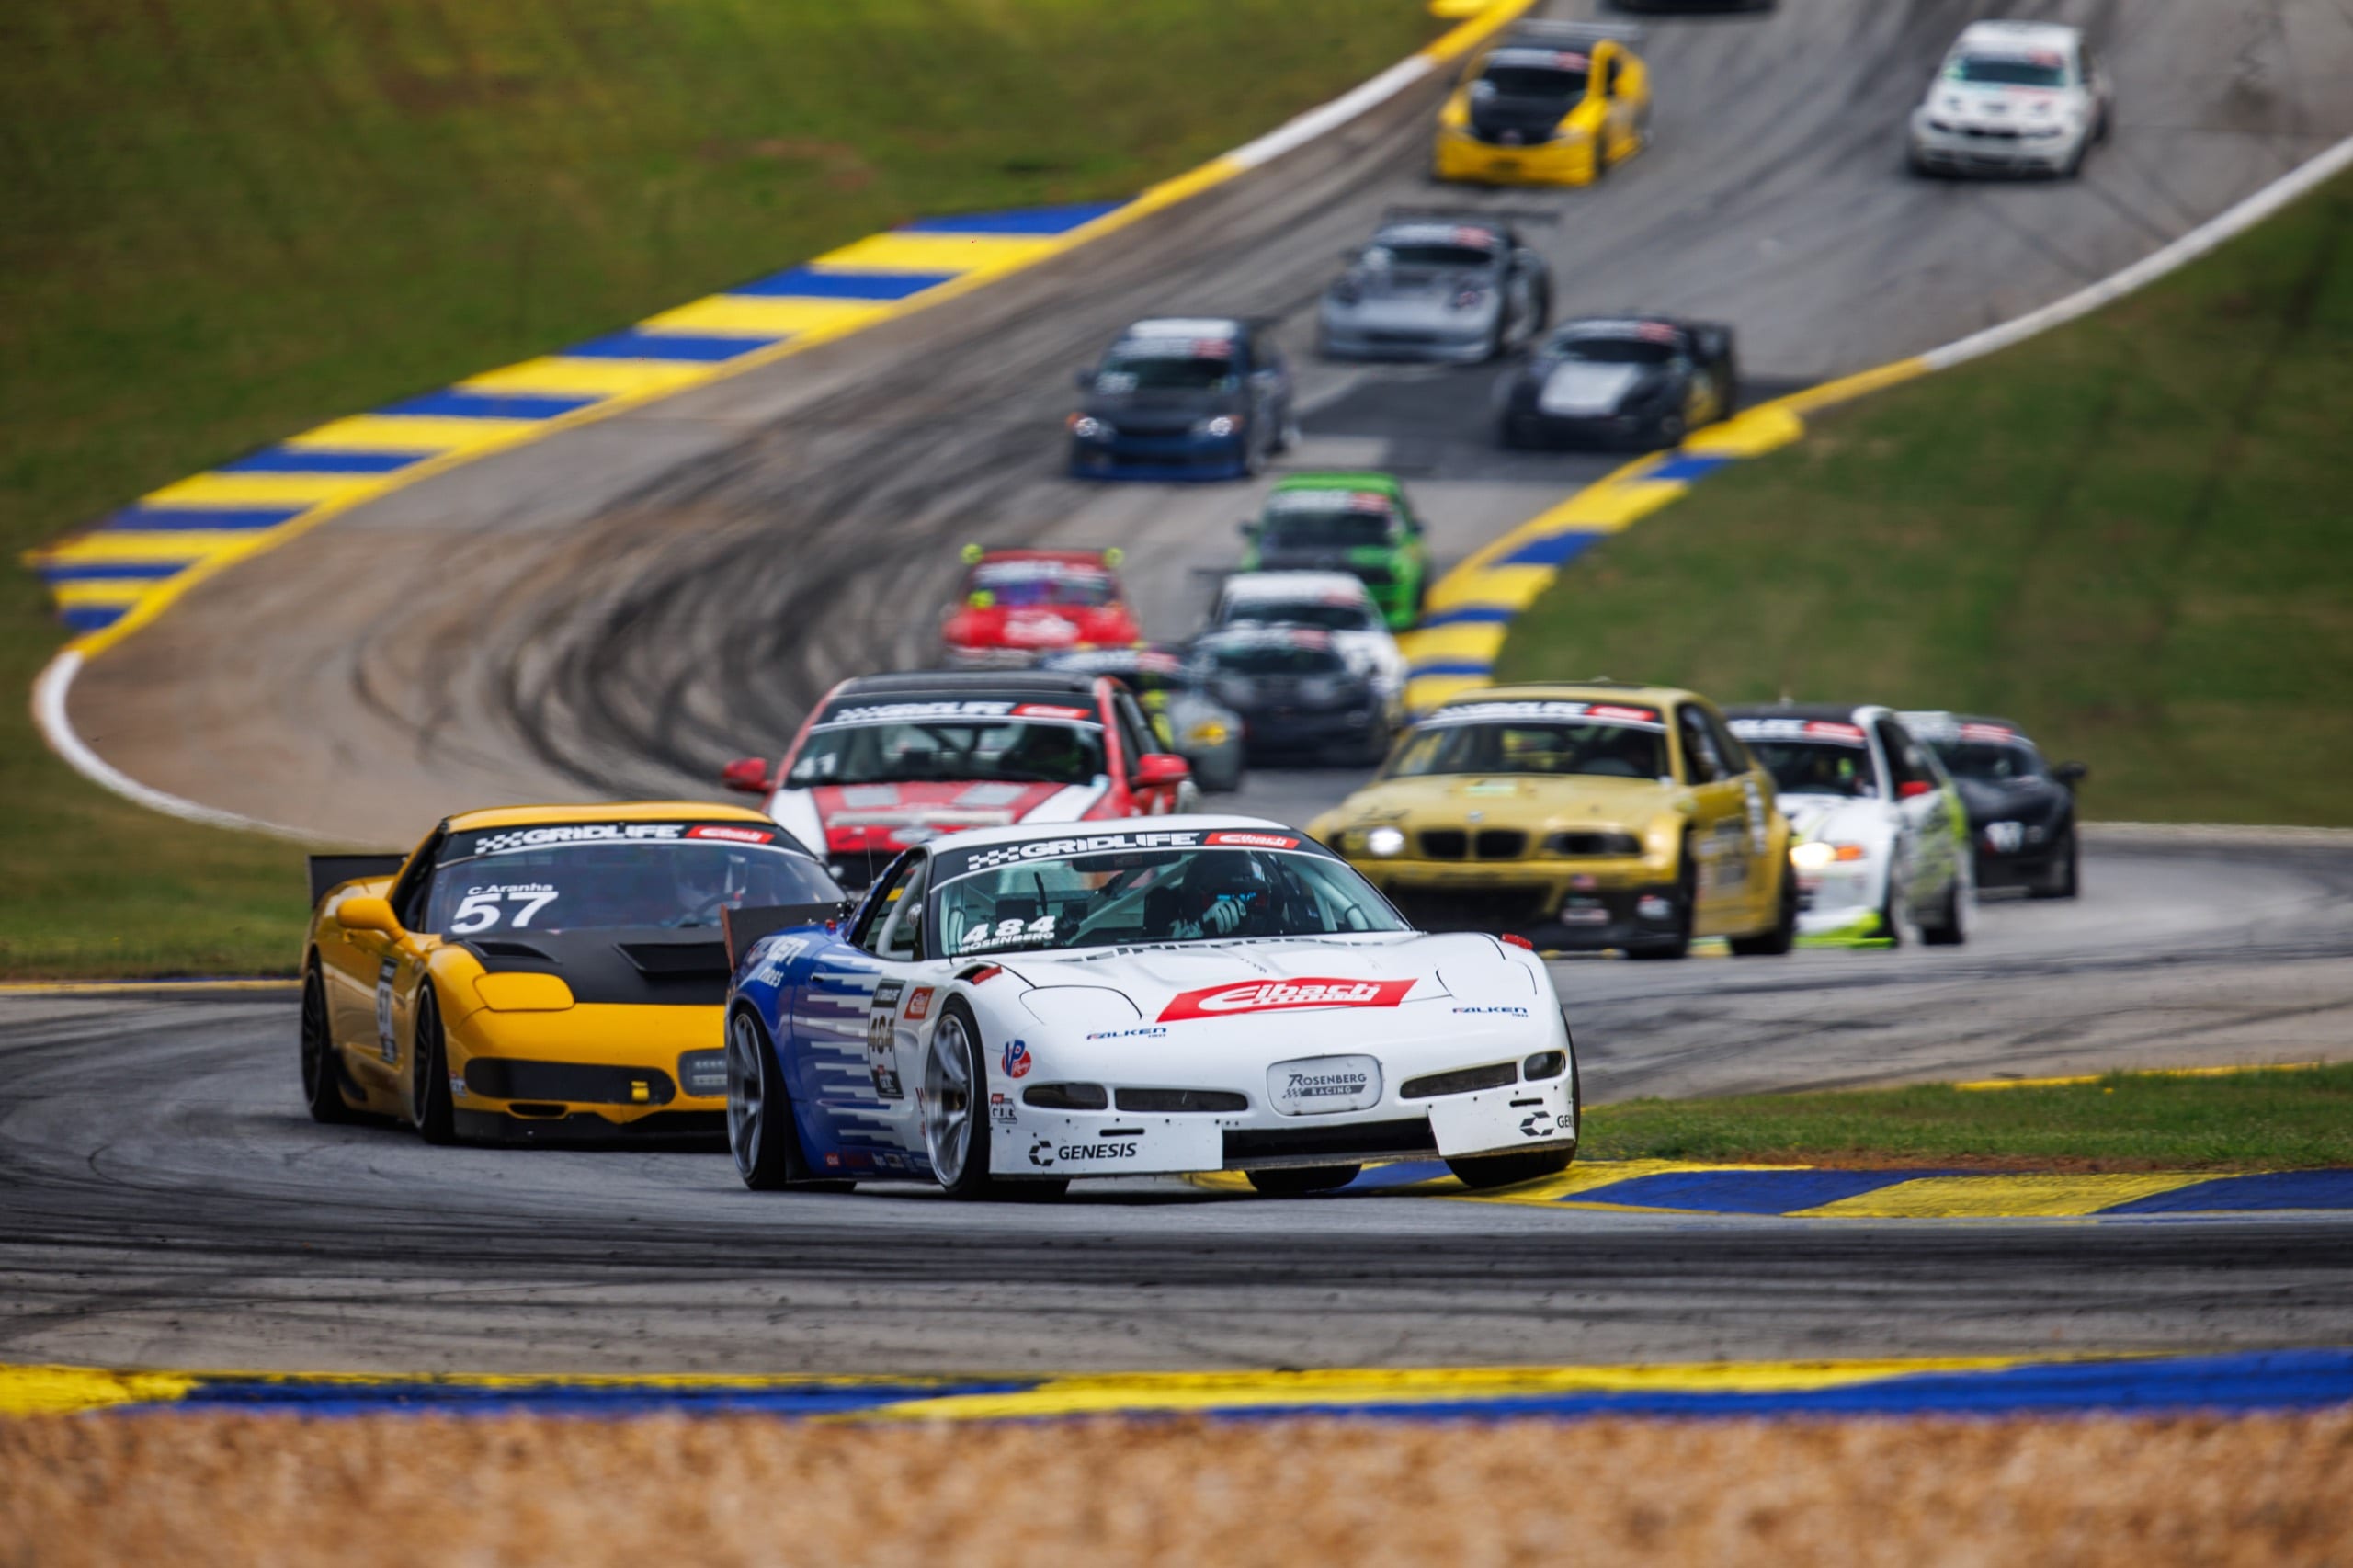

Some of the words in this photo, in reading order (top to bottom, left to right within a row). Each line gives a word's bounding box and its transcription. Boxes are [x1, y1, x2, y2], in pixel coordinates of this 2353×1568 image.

[521, 824, 686, 845] GRIDLIFE
[1019, 832, 1200, 858] GRIDLIFE
[450, 891, 559, 935] 57
[962, 915, 1056, 945] 484
[1198, 983, 1381, 1010] Eibach
[1006, 1040, 1026, 1077] VP
[1312, 1086, 1352, 1096] RACING
[1058, 1142, 1137, 1160] GENESIS
